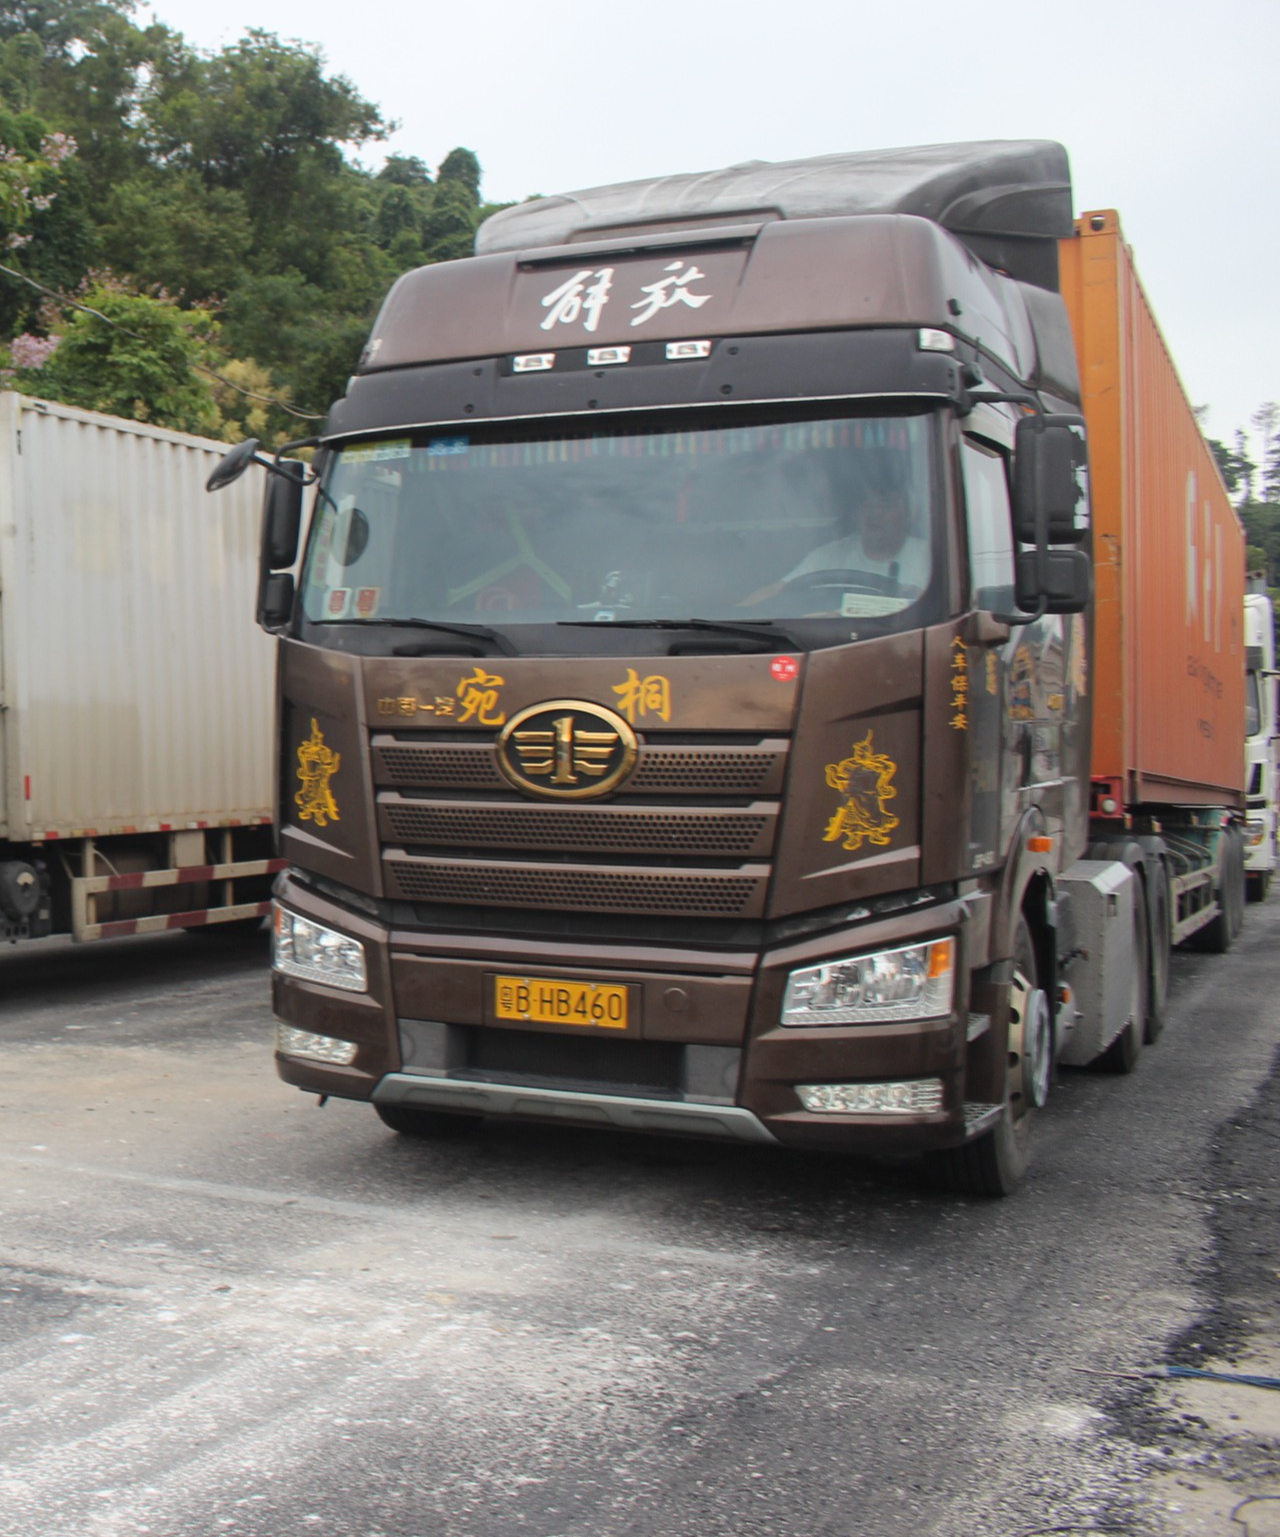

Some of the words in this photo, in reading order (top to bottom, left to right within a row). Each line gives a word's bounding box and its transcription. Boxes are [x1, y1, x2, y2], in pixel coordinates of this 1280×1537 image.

[540, 261, 713, 332] 解放
[456, 667, 506, 725] 宛
[611, 668, 670, 723] 桐
[948, 635, 969, 731] 人车保平安
